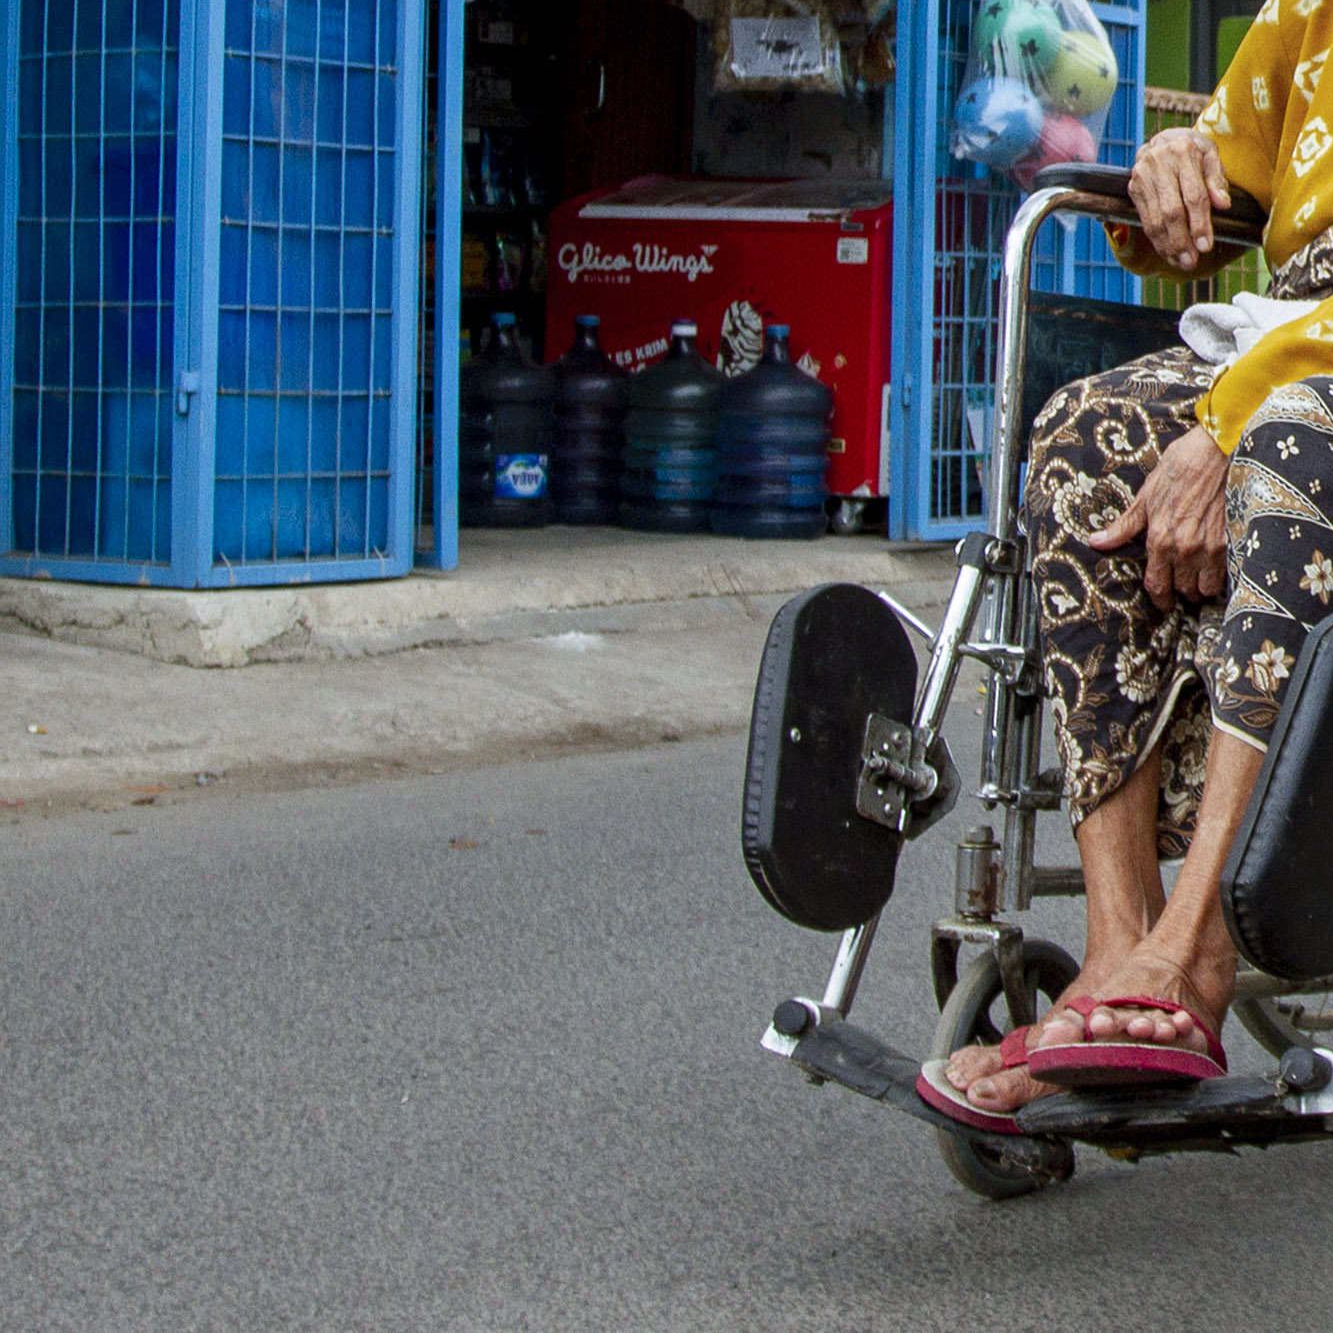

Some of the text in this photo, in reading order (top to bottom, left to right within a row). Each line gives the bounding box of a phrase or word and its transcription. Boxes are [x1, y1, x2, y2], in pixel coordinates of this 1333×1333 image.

[558, 242, 715, 284] Glico Wings
[635, 336, 669, 362] KRIM
